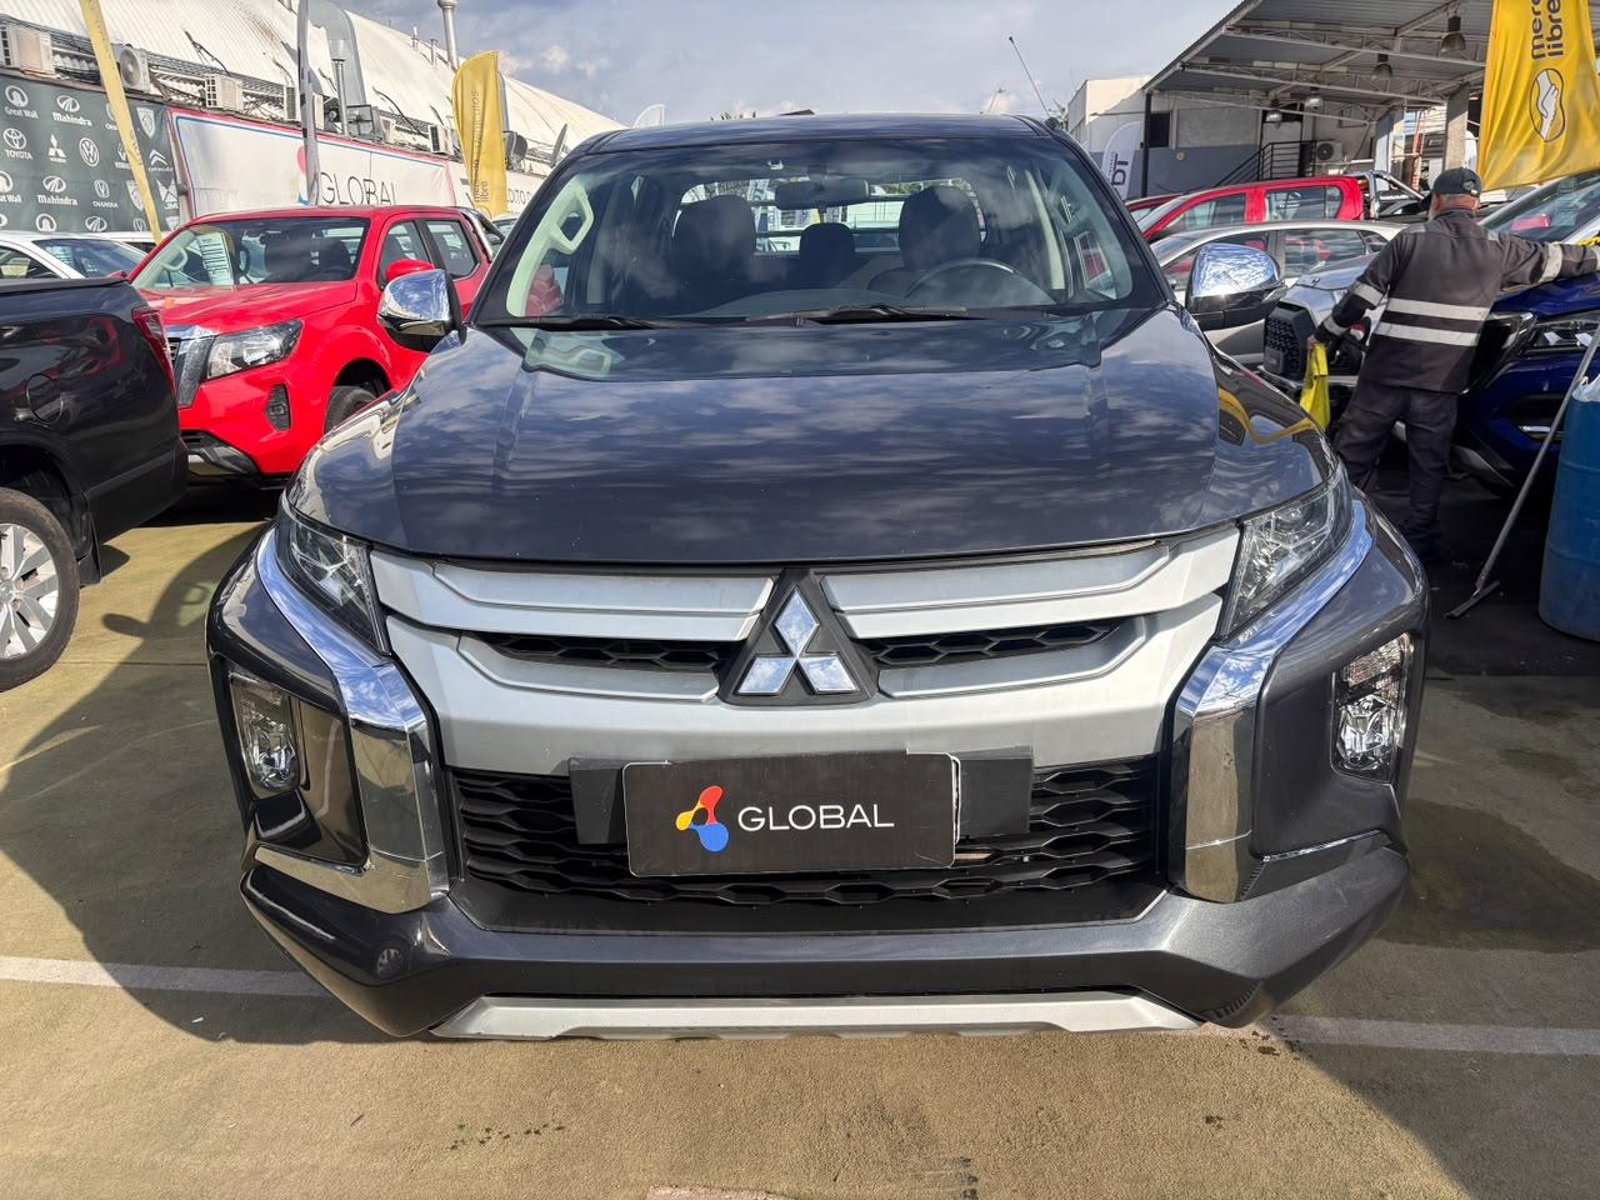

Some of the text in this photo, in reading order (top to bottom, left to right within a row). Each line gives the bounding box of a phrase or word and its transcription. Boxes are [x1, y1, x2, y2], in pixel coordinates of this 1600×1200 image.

[1546, 0, 1563, 56] libre
[52, 112, 92, 126] Mahindra
[5, 149, 33, 160] TOYOTA
[36, 194, 78, 206] Mahindra
[738, 804, 895, 832] GLOBAL
